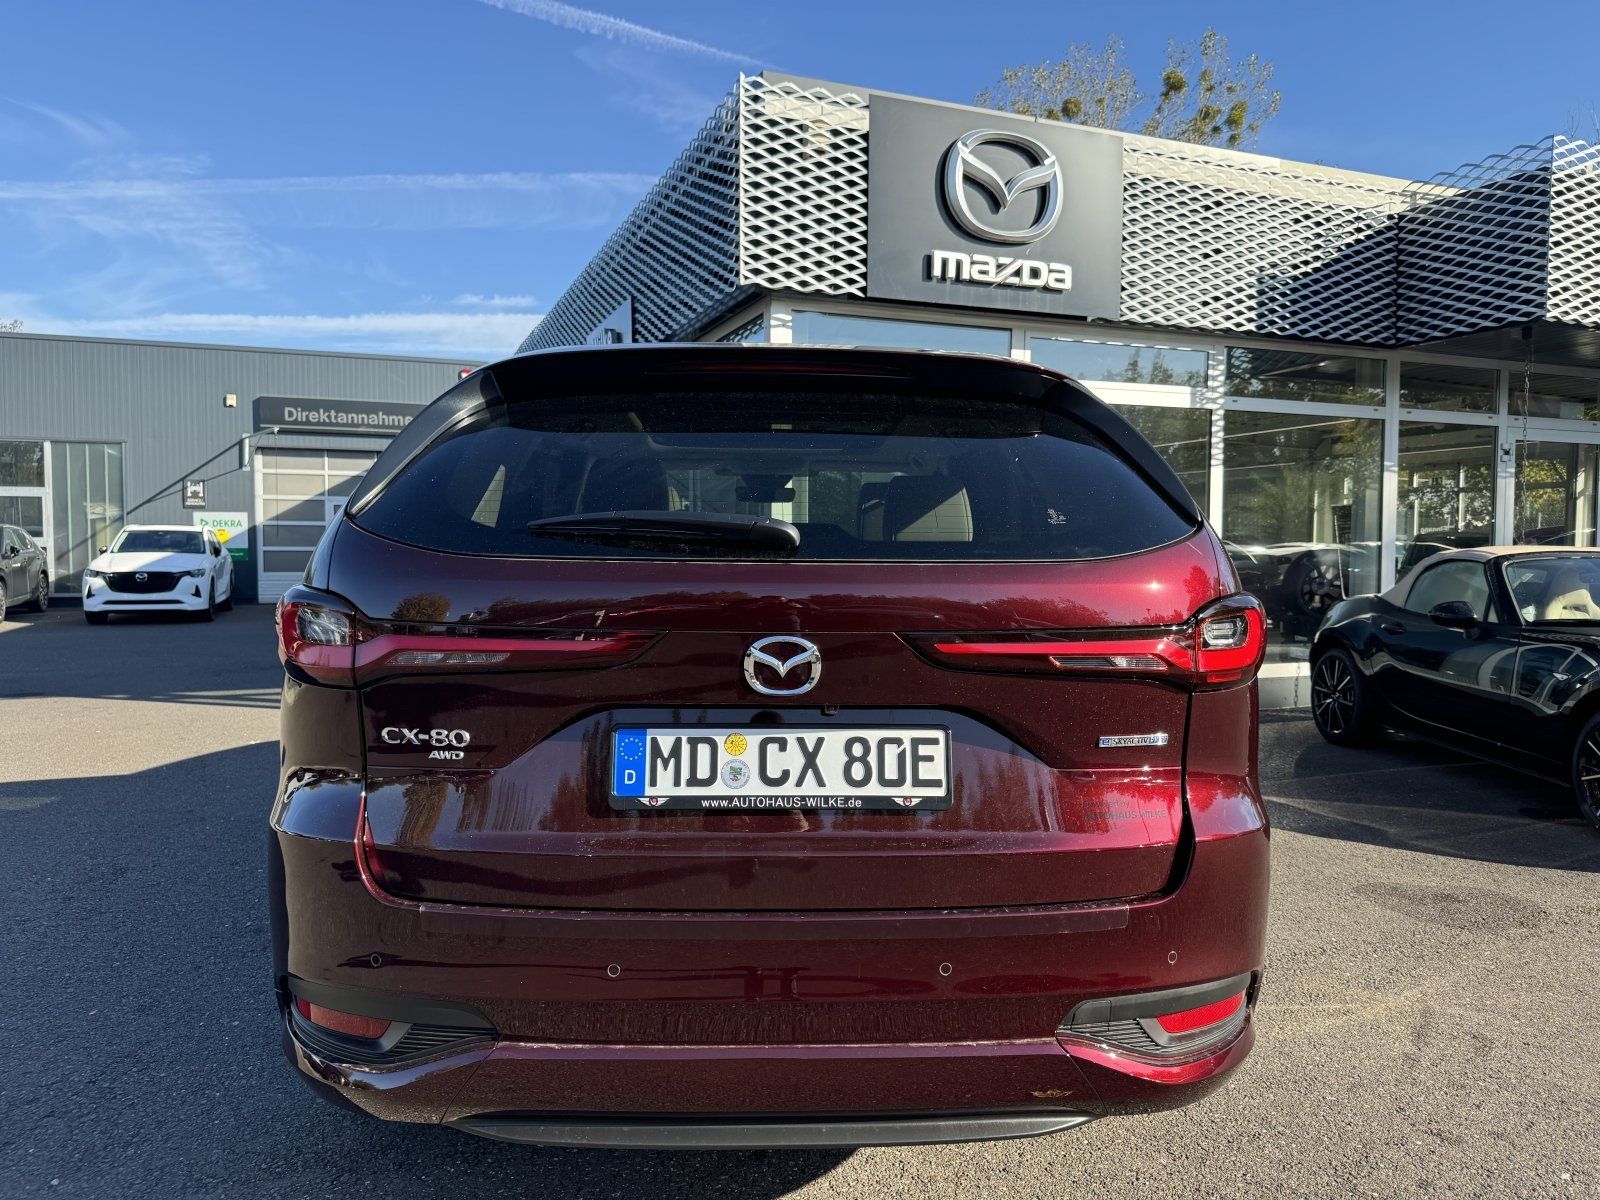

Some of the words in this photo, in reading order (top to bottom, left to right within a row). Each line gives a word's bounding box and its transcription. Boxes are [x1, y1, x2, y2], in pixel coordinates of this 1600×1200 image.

[284, 407, 413, 426] Direktannahme
[212, 519, 243, 528] DEKRA
[381, 726, 471, 747] CX-80
[428, 750, 465, 760] AWD
[649, 736, 719, 788] MD
[758, 736, 827, 788] CX
[844, 736, 944, 788] 80E
[624, 769, 636, 785] D
[701, 796, 862, 809] www.AUTOHAUS-WILKE.de
[1140, 809, 1167, 818] WILKE
